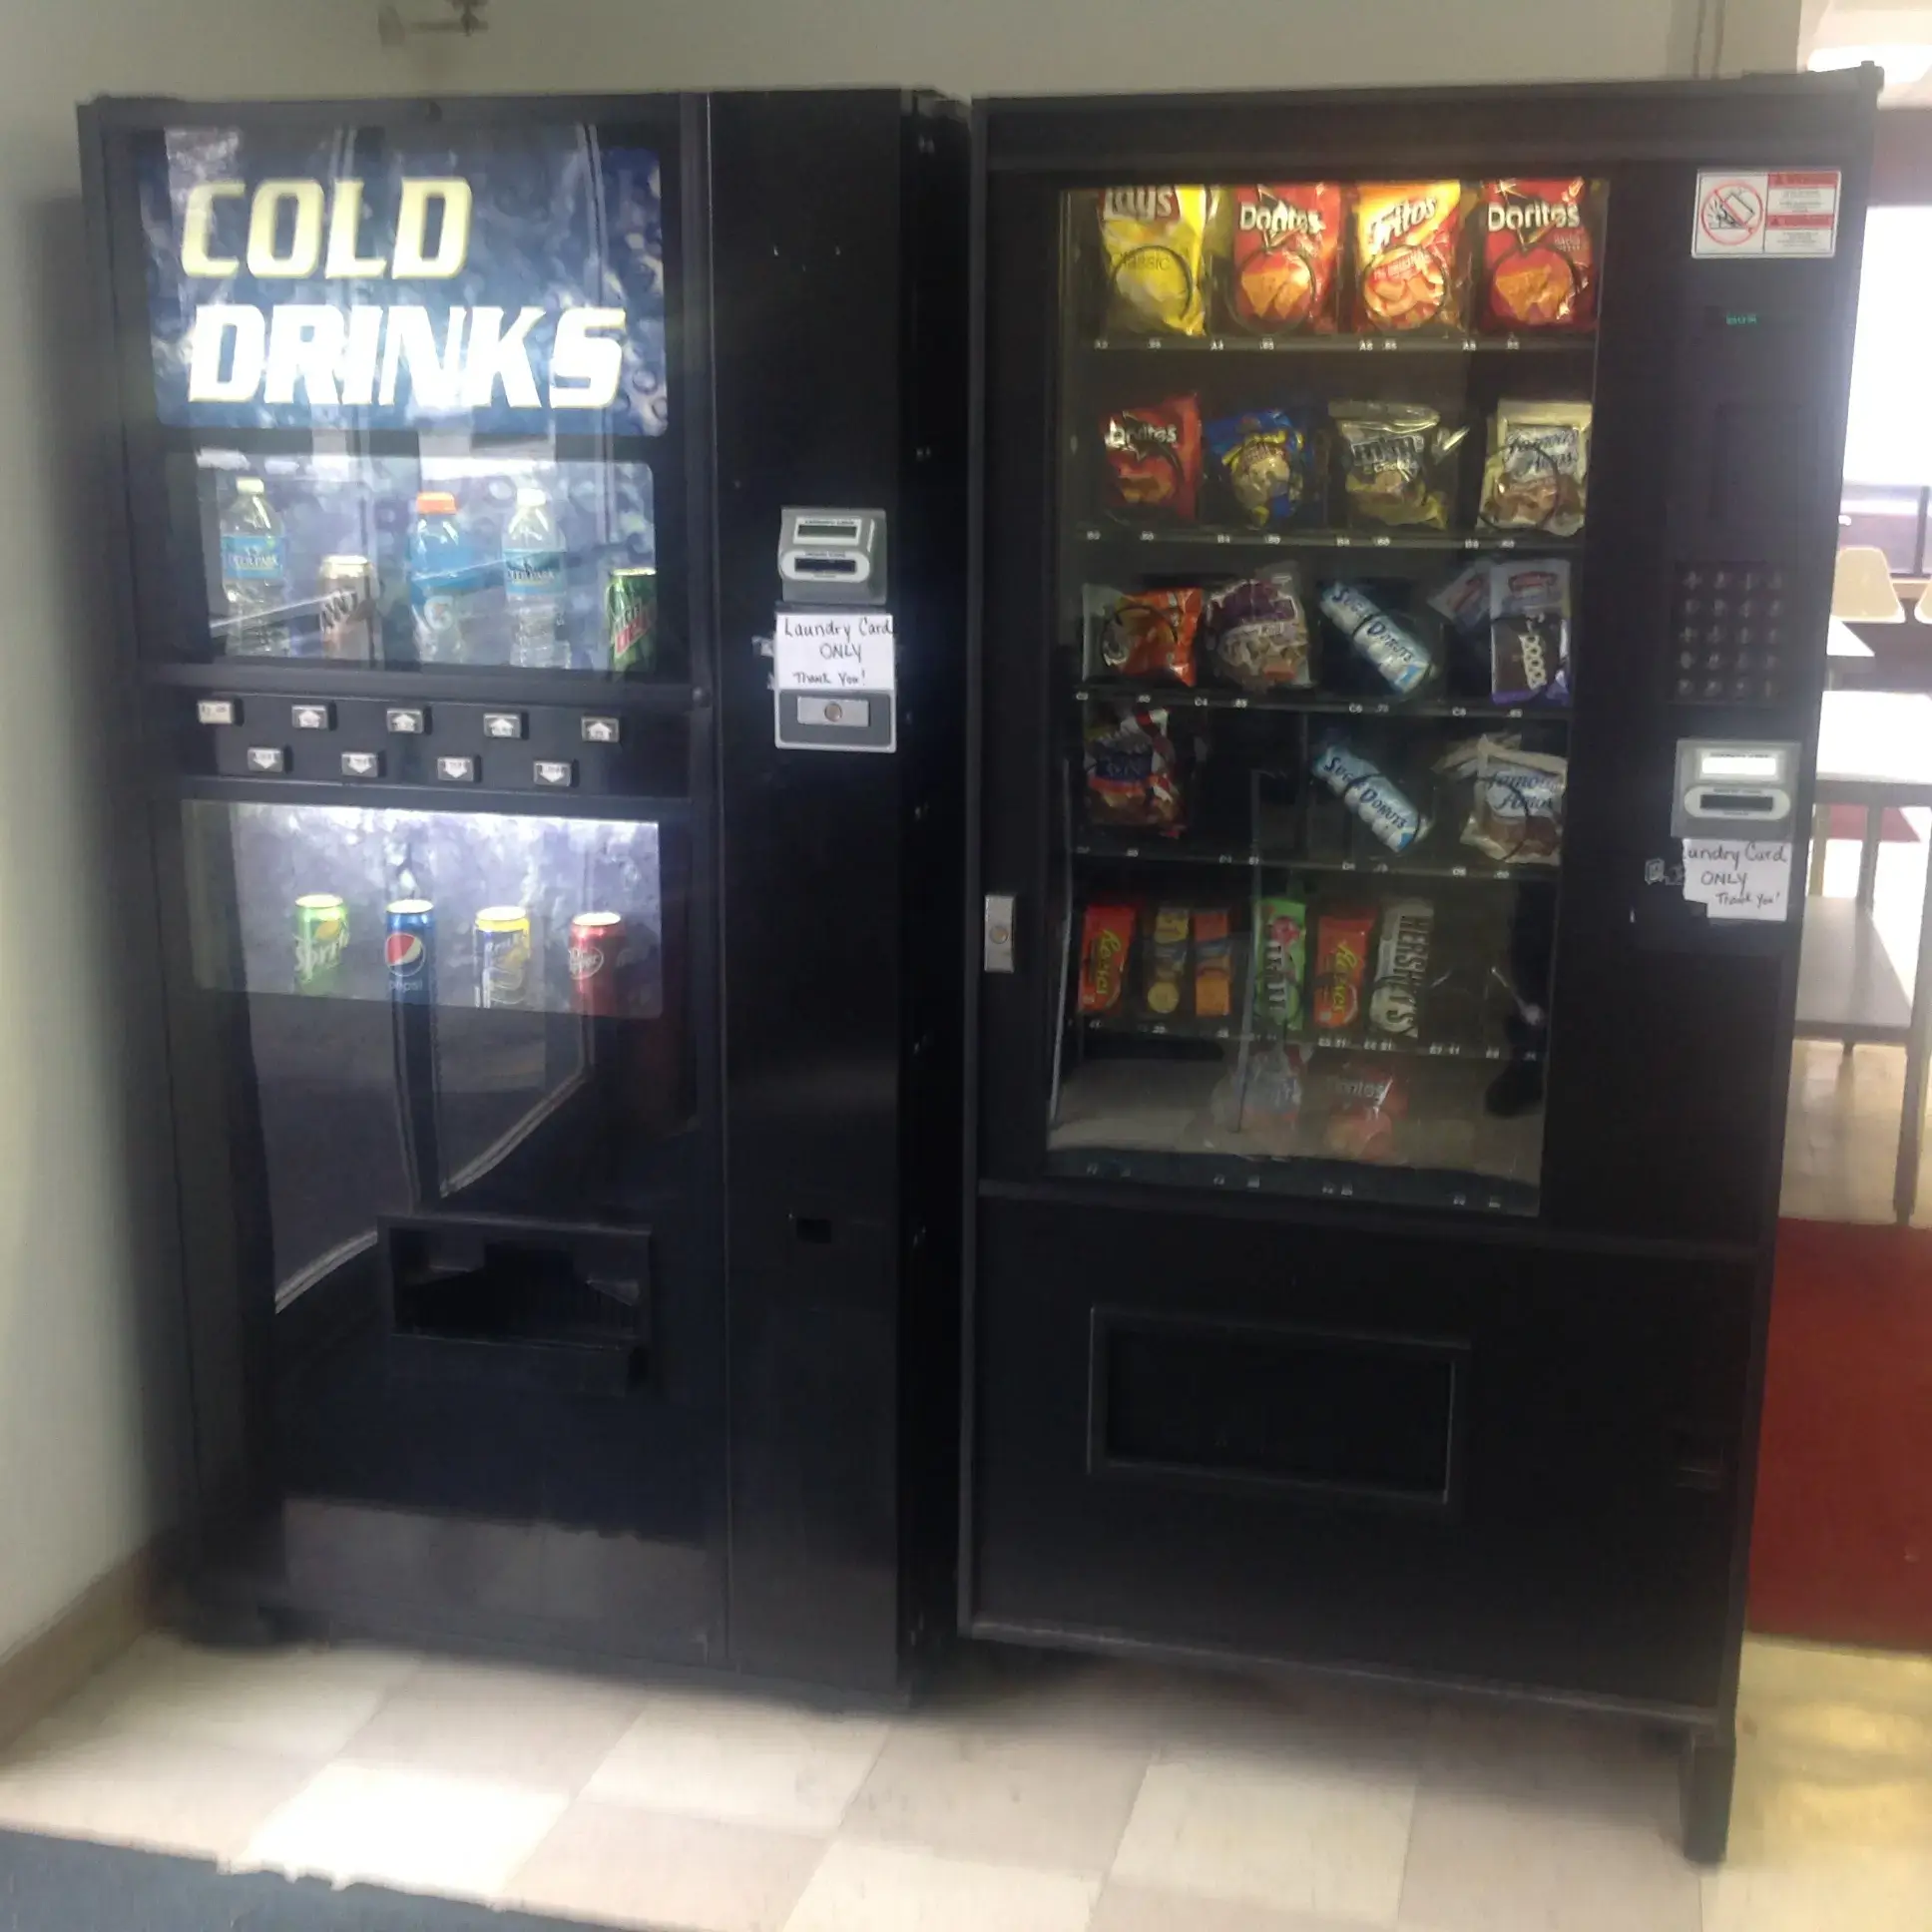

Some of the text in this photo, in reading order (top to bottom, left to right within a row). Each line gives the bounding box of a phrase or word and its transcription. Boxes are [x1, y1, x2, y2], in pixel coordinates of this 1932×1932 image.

[181, 178, 473, 280] COLD
[1239, 202, 1325, 236] Doritos
[1369, 197, 1438, 255] Fritos
[1488, 200, 1580, 232] Doritos
[188, 304, 627, 409] DRINKS
[784, 617, 893, 643] Laundry Card
[820, 642, 862, 662] ONLY
[792, 670, 866, 686] Thank You!
[1684, 843, 1787, 869] undry Card
[1700, 871, 1748, 892] ONLY
[1715, 892, 1751, 905] Thank
